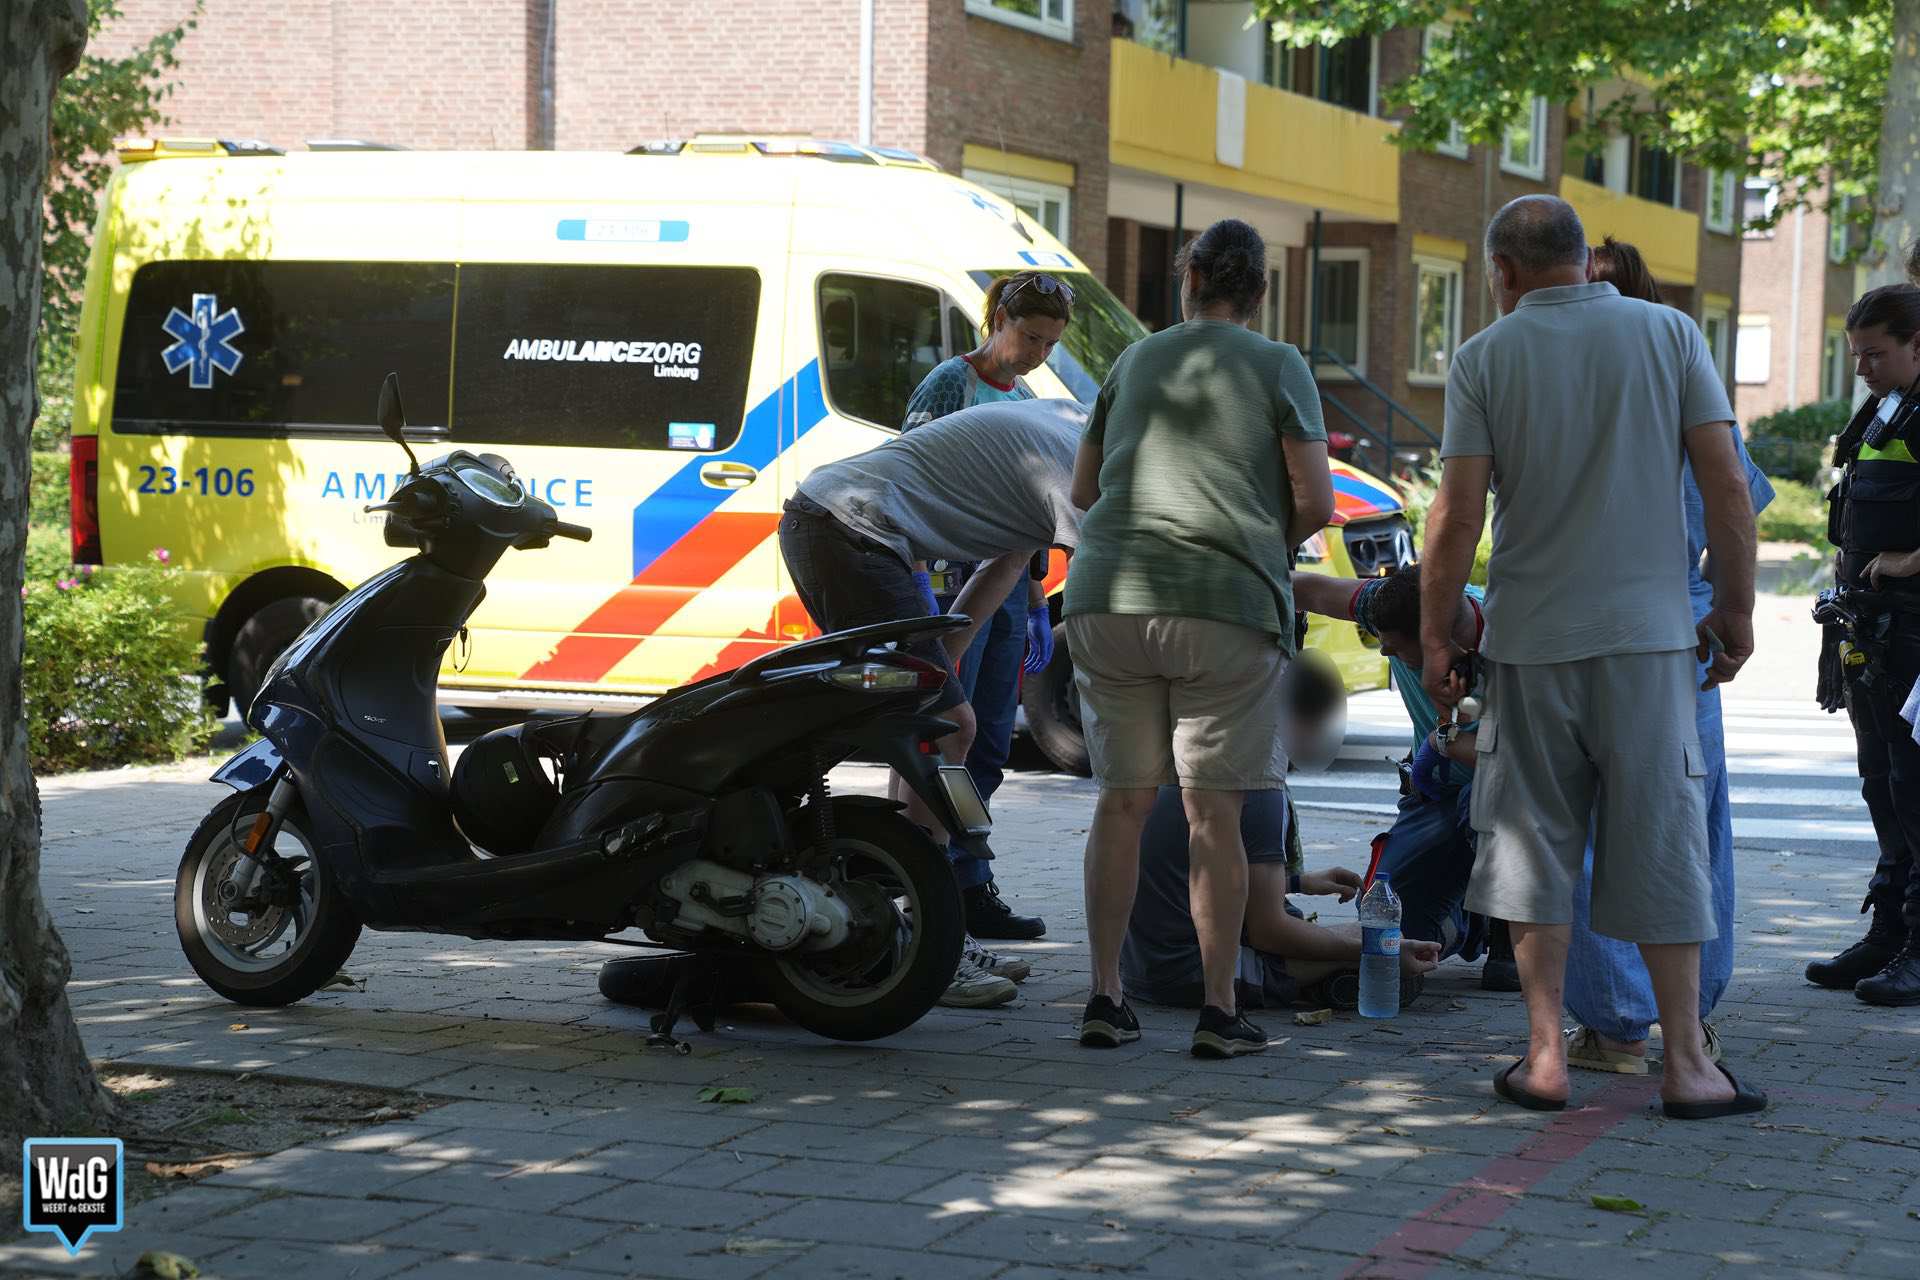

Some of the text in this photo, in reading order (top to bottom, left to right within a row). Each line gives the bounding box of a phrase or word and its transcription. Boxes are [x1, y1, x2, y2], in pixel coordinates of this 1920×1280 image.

[504, 339, 701, 363] AMBULANCEZORG
[654, 365, 698, 380] Limburg
[138, 465, 255, 496] 23-106
